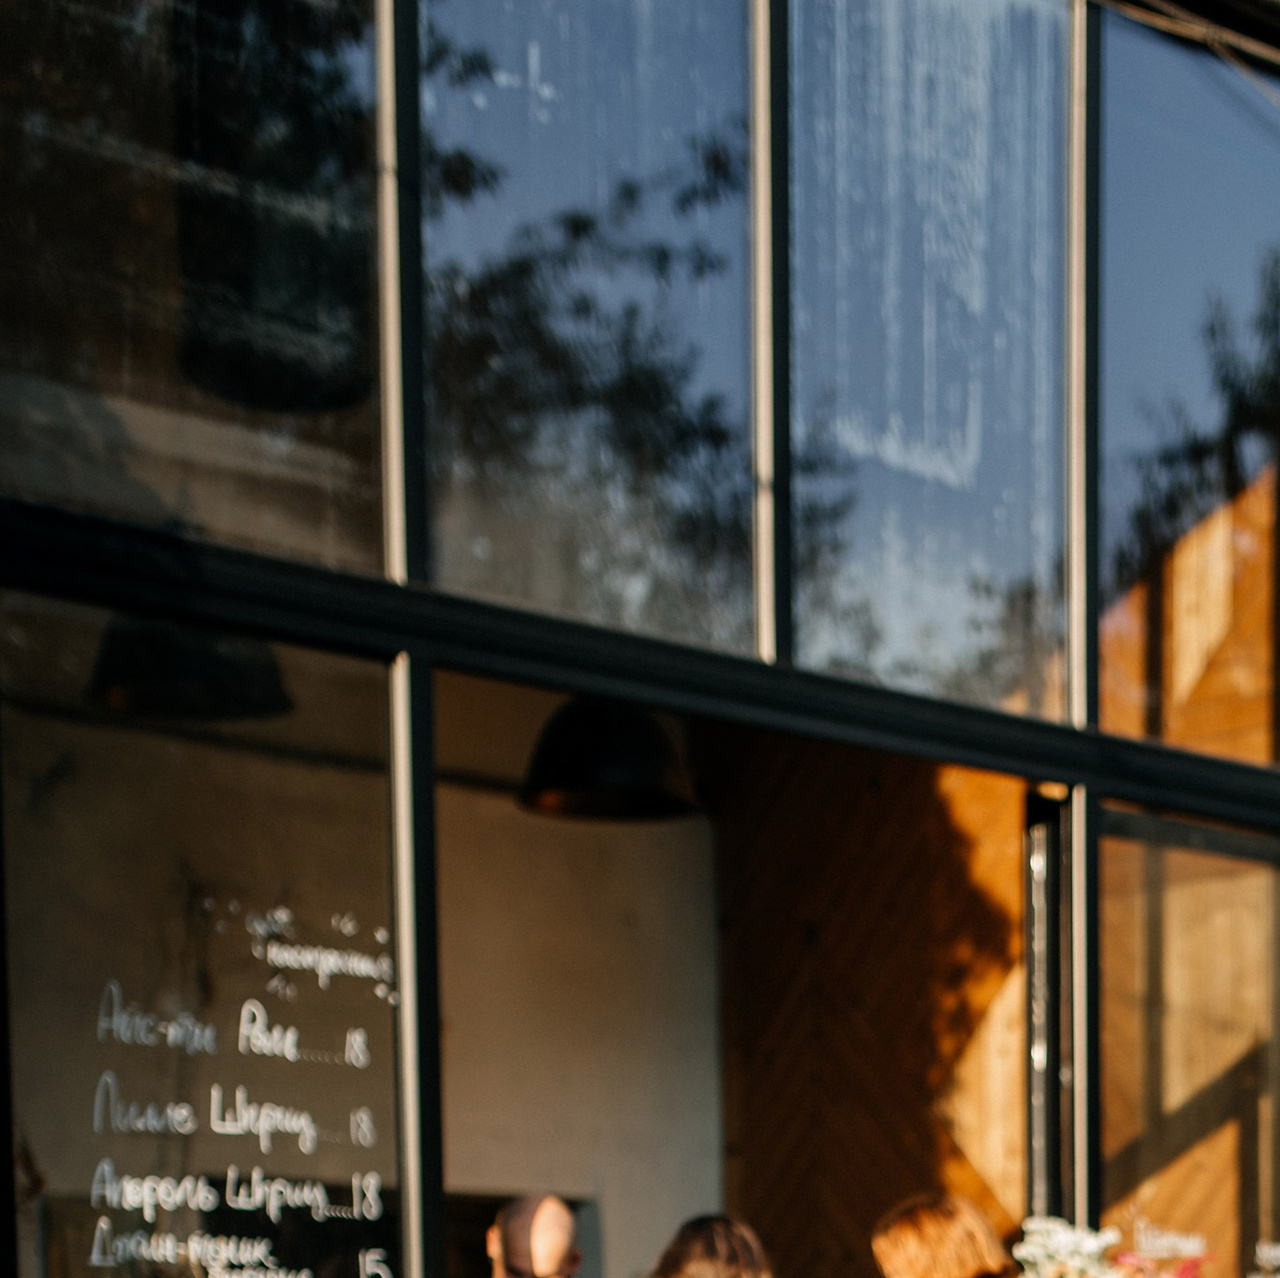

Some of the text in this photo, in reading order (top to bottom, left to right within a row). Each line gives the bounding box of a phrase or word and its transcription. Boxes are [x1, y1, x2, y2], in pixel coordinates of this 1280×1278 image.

[344, 1026, 371, 1070] 18
[350, 1106, 378, 1148] 18
[91, 1157, 219, 1223] Апероль
[351, 1171, 383, 1221] 18
